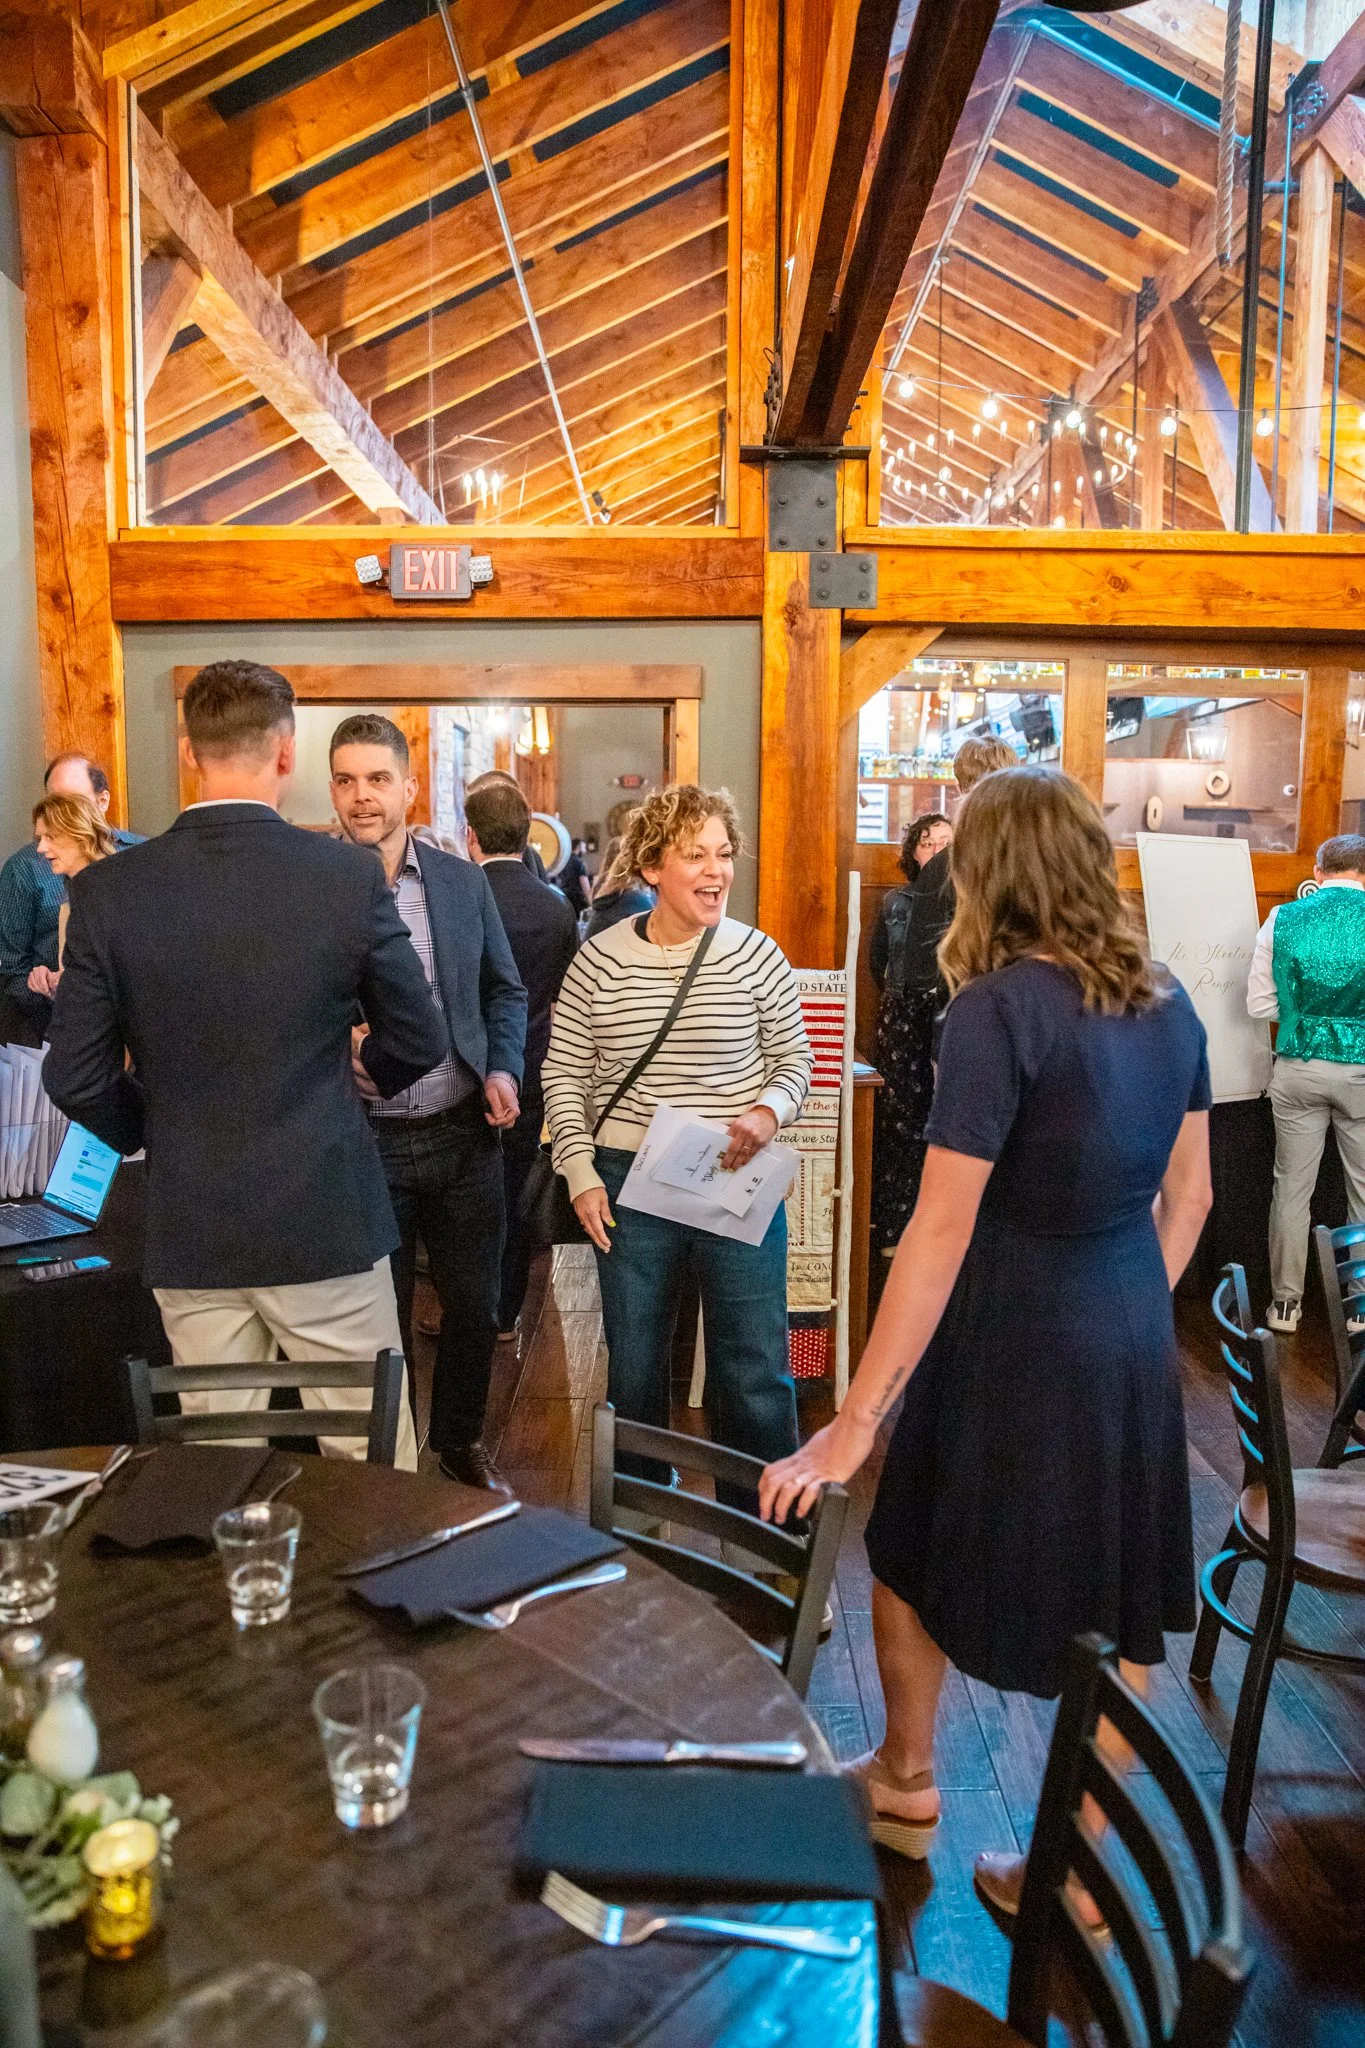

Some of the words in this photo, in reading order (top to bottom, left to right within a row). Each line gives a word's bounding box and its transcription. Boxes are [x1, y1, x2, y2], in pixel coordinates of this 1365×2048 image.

[404, 549, 461, 591] EXIT
[828, 973, 841, 981] OF
[813, 1101, 831, 1111] the
[801, 1136, 819, 1144] we
[819, 1134, 837, 1144] Sta
